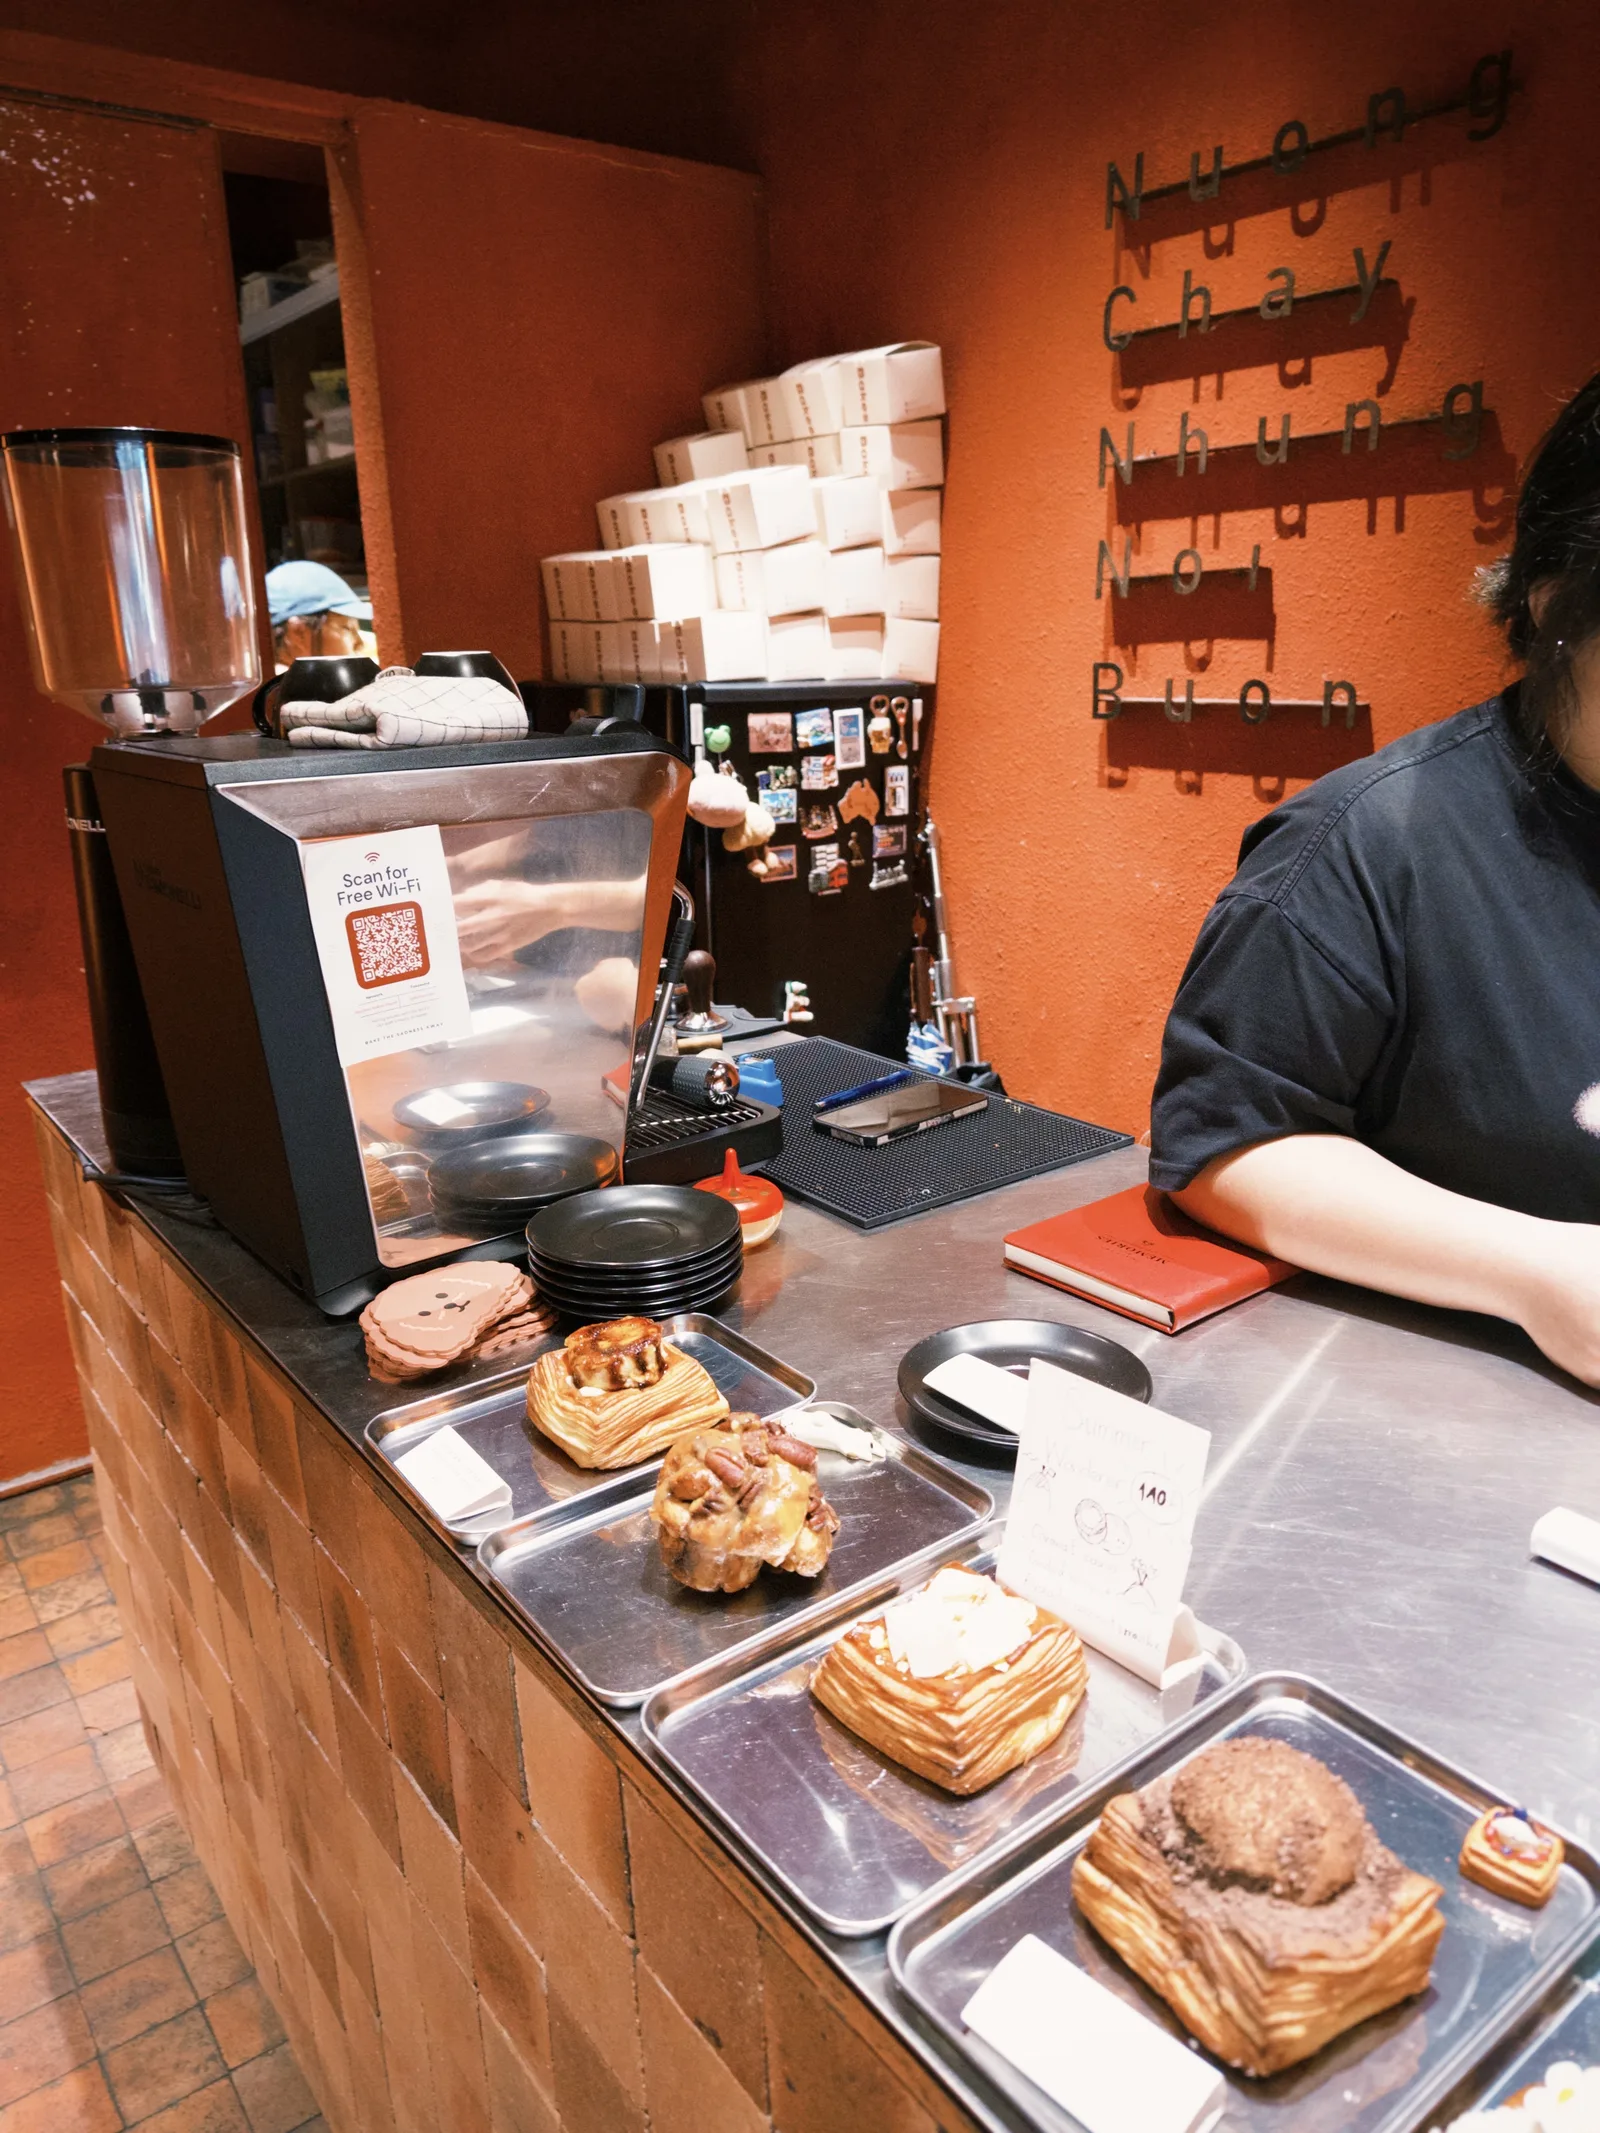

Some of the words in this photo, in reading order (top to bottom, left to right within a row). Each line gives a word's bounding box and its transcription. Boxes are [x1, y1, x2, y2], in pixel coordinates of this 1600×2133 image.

[1103, 240, 1392, 352] Chay
[1099, 380, 1485, 490] Nhung
[1092, 662, 1358, 729] Buon
[336, 887, 374, 906] Free
[377, 878, 422, 900] Wi-Fi
[342, 868, 384, 888] Scan
[386, 866, 409, 879] for
[1138, 1481, 1168, 1506] 140
